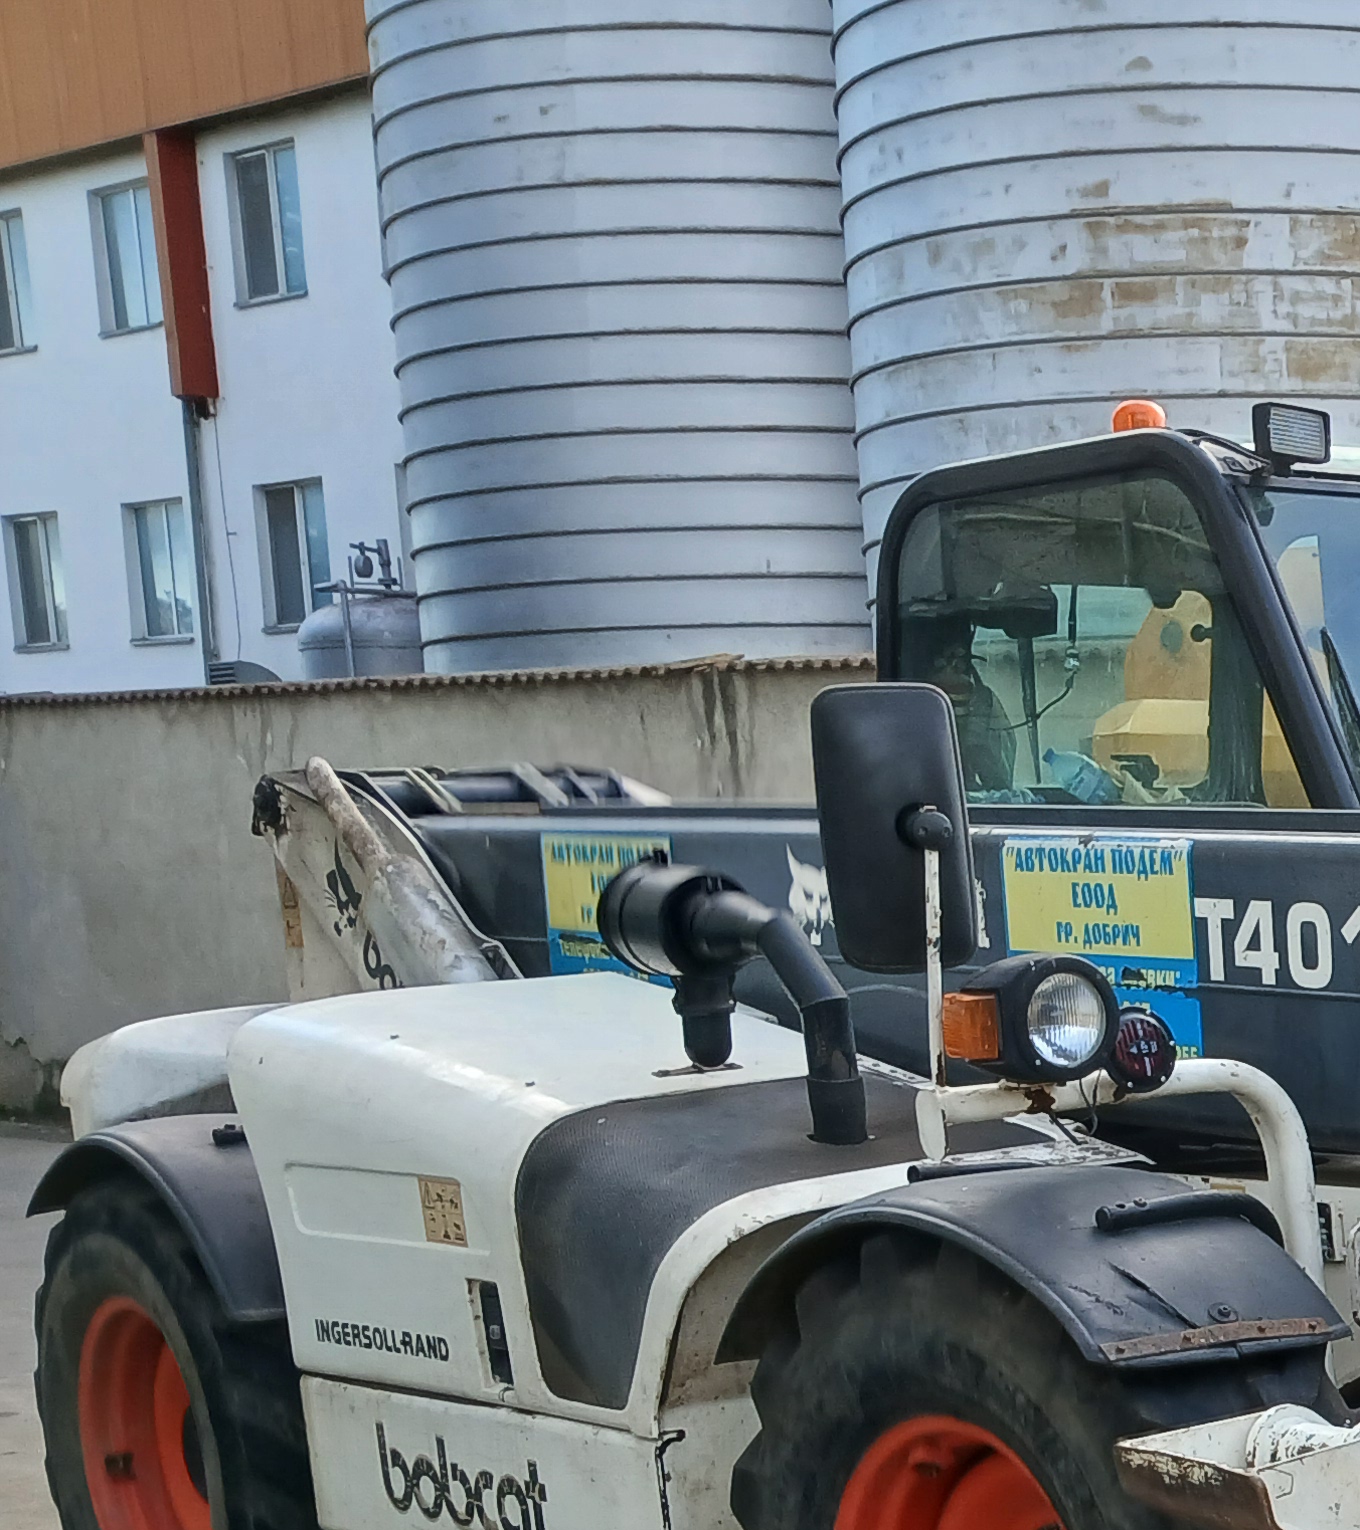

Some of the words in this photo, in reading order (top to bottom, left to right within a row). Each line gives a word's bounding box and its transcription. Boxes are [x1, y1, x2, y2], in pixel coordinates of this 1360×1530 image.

[1006, 846, 1106, 876] "АВТОКРАН
[1071, 881, 1118, 916] ЕООД
[1056, 921, 1078, 944] ГР.
[1083, 922, 1141, 950] ДОБРИЧ
[314, 1318, 450, 1362] INGERSOLL-RAND
